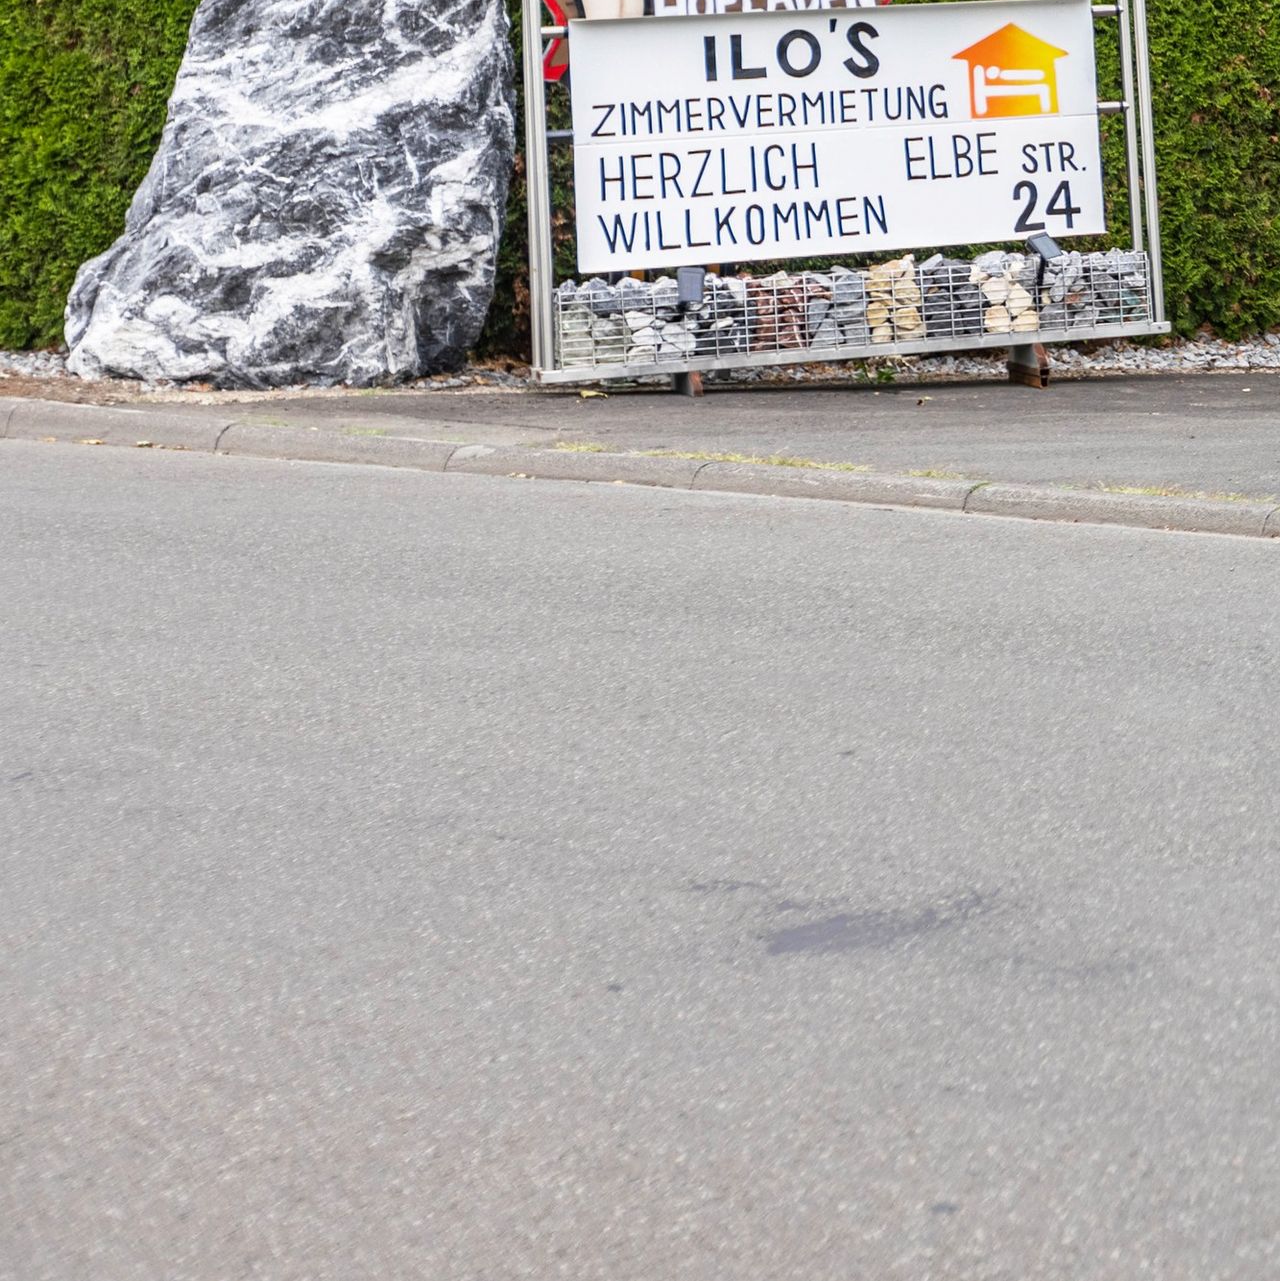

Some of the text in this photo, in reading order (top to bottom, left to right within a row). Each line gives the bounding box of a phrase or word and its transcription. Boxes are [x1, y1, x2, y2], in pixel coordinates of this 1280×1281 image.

[704, 18, 880, 81] ILO'S
[591, 84, 949, 137] ZIMMERVERMIETUNG
[600, 142, 819, 201] HERZLICH
[904, 132, 1086, 180] ELBE STR.
[597, 195, 888, 254] WILLKOMMEN
[1013, 180, 1081, 232] 24
